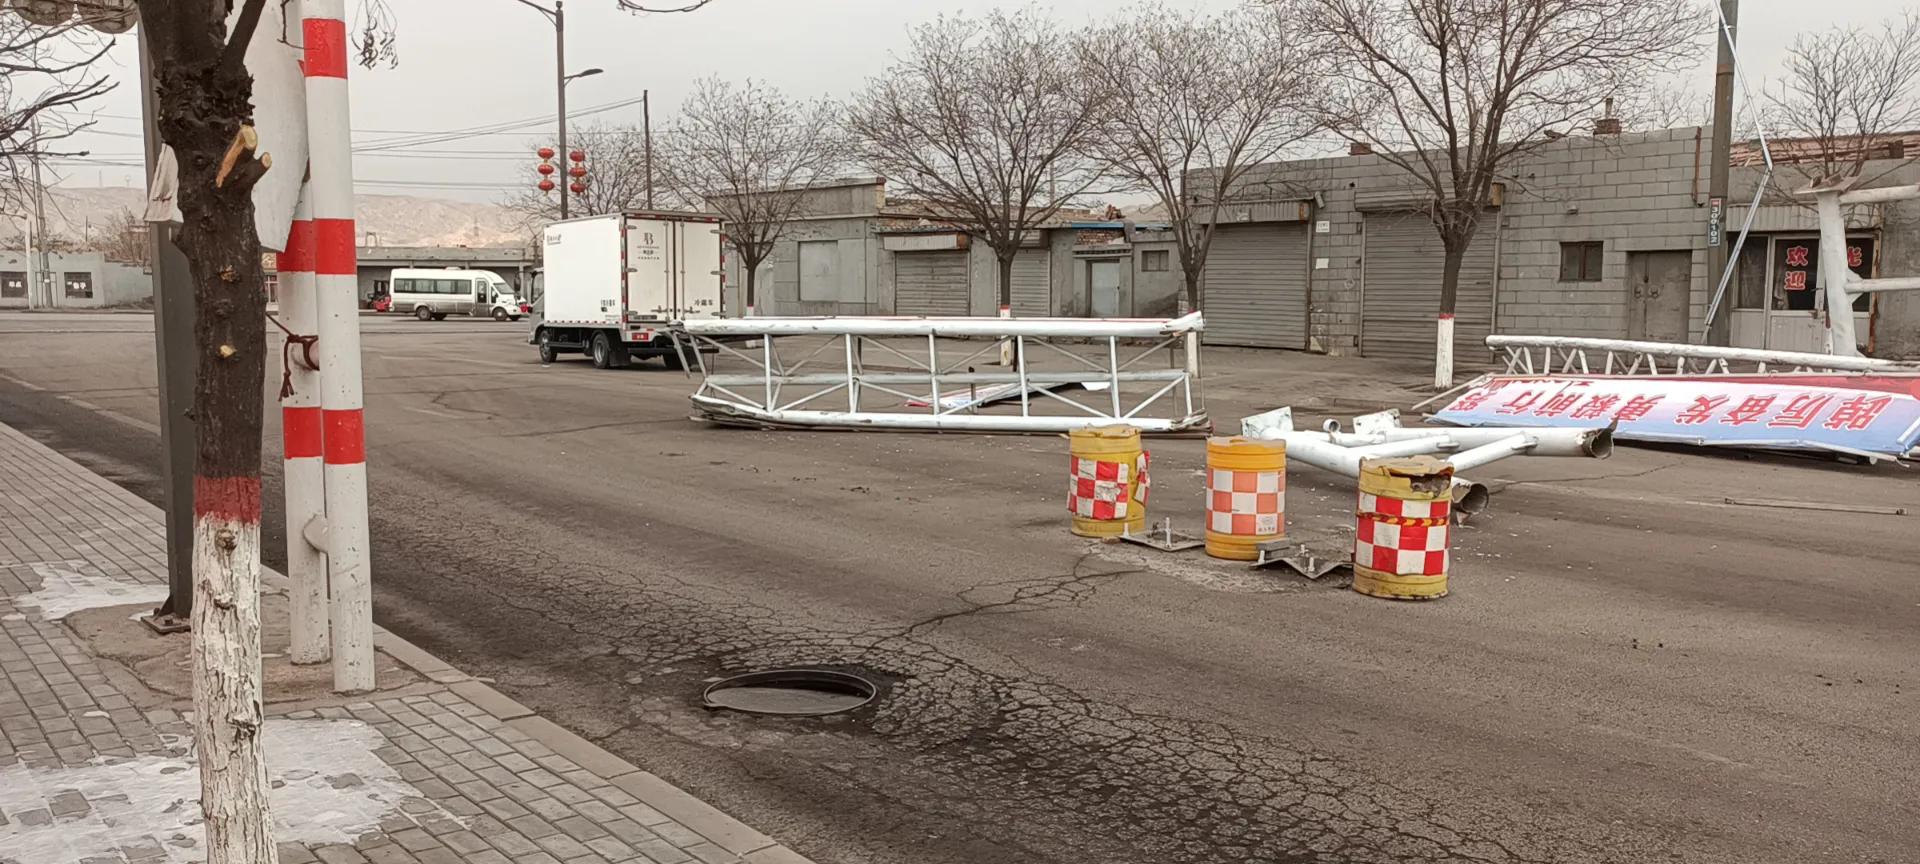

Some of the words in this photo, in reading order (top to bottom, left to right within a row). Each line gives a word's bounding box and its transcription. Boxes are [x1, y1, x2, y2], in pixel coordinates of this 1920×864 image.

[1784, 246, 1808, 290] 欢迎
[1495, 389, 1667, 422] 勇毅前行
[1675, 393, 1894, 430] 踔厉奋发
